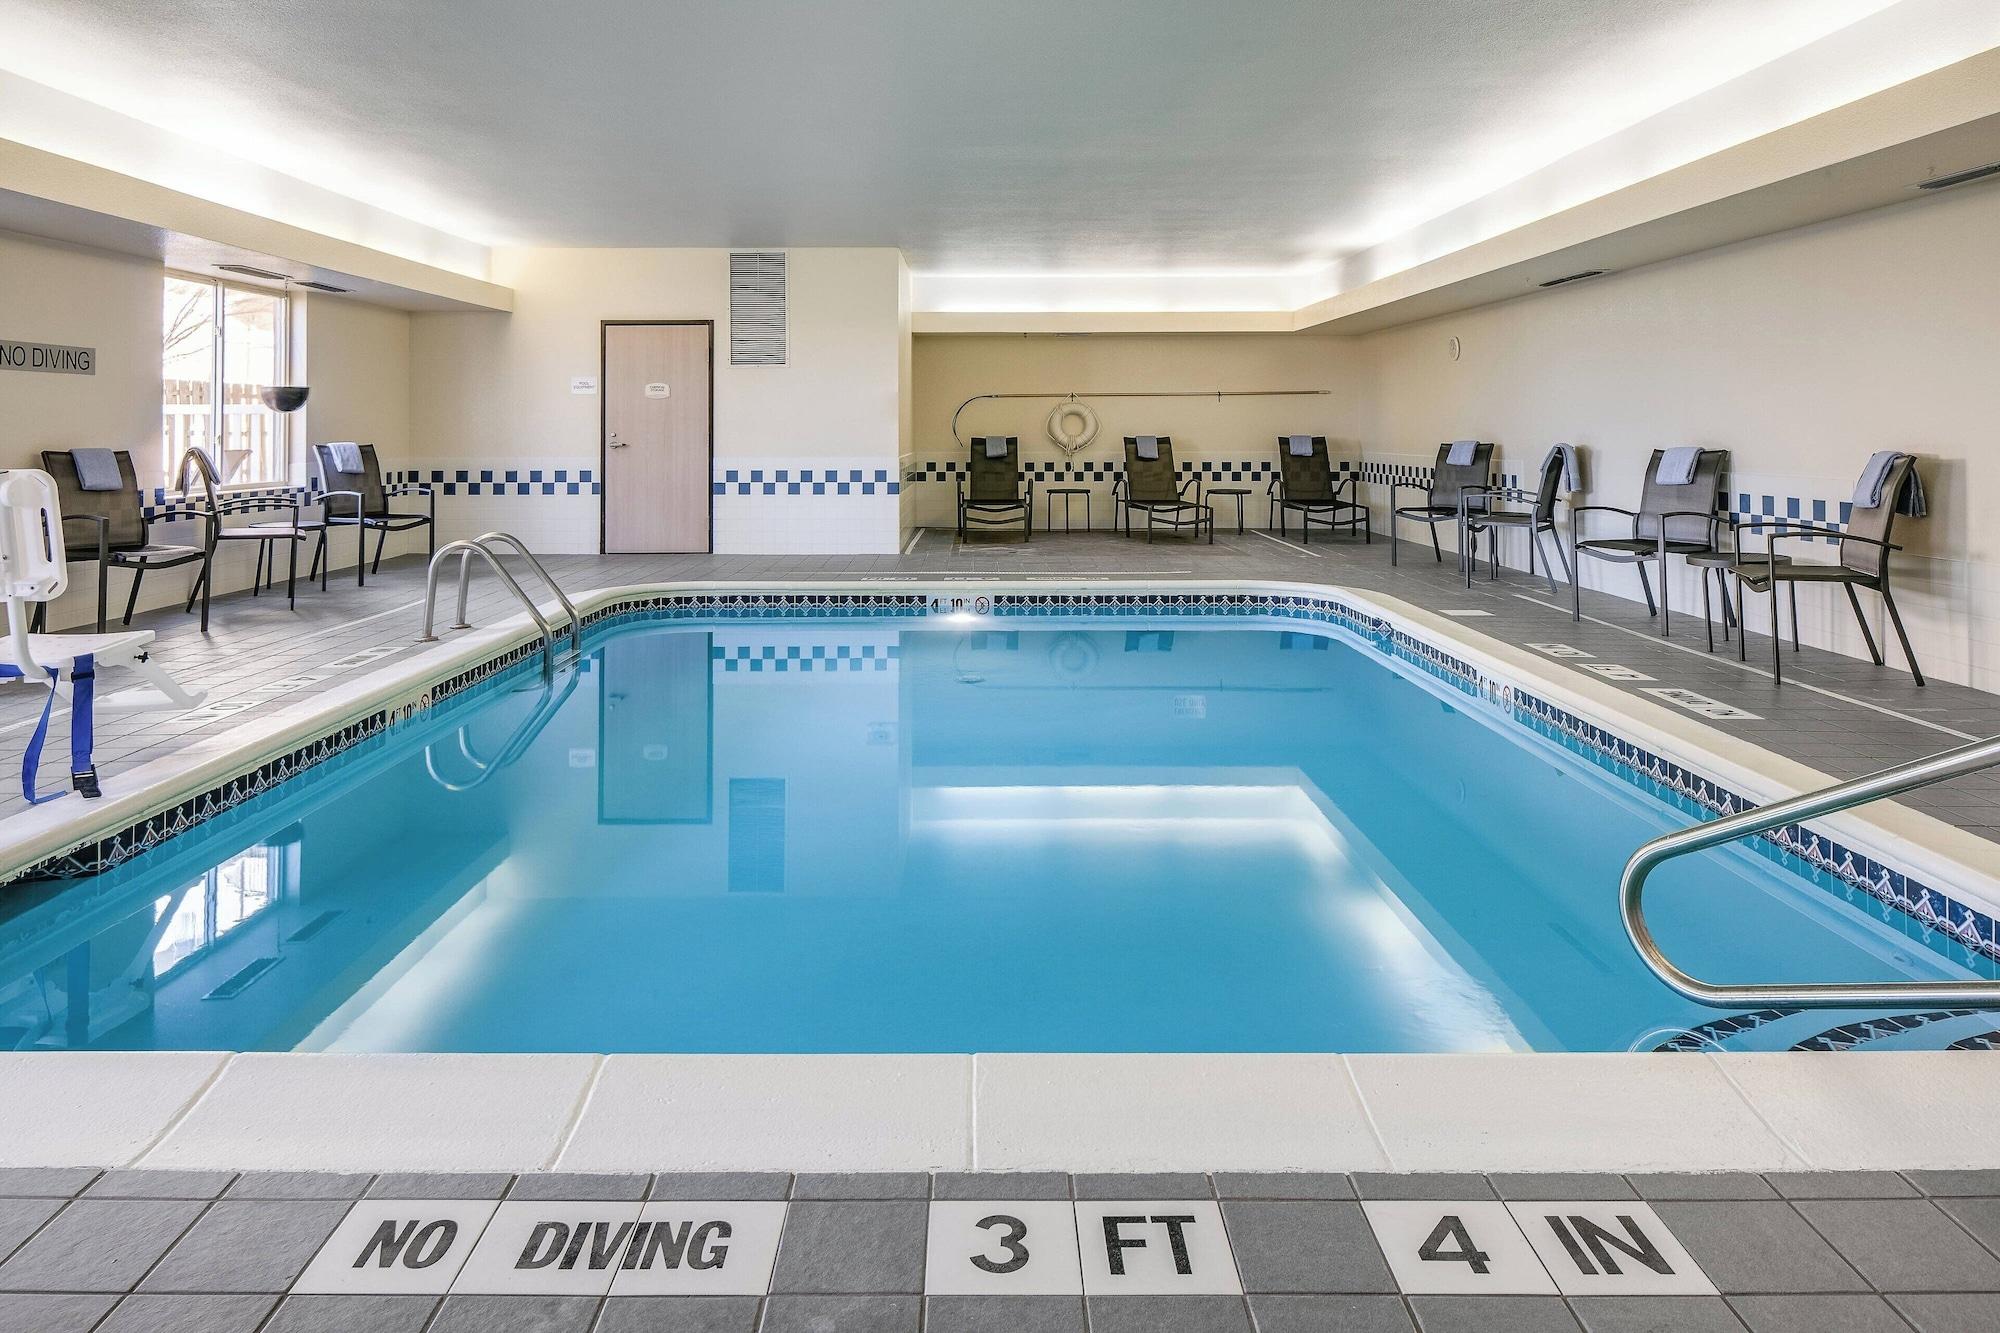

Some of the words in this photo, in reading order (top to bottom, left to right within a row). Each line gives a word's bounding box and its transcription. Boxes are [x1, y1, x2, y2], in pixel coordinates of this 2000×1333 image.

[0, 344, 26, 367] NO
[32, 347, 90, 371] DIVING
[352, 1219, 459, 1269] NO
[515, 1221, 732, 1269] DIVING
[970, 1215, 1029, 1273] 3
[1103, 1216, 1195, 1275] FT
[1418, 1216, 1490, 1274] 4
[1544, 1215, 1676, 1275] IN
